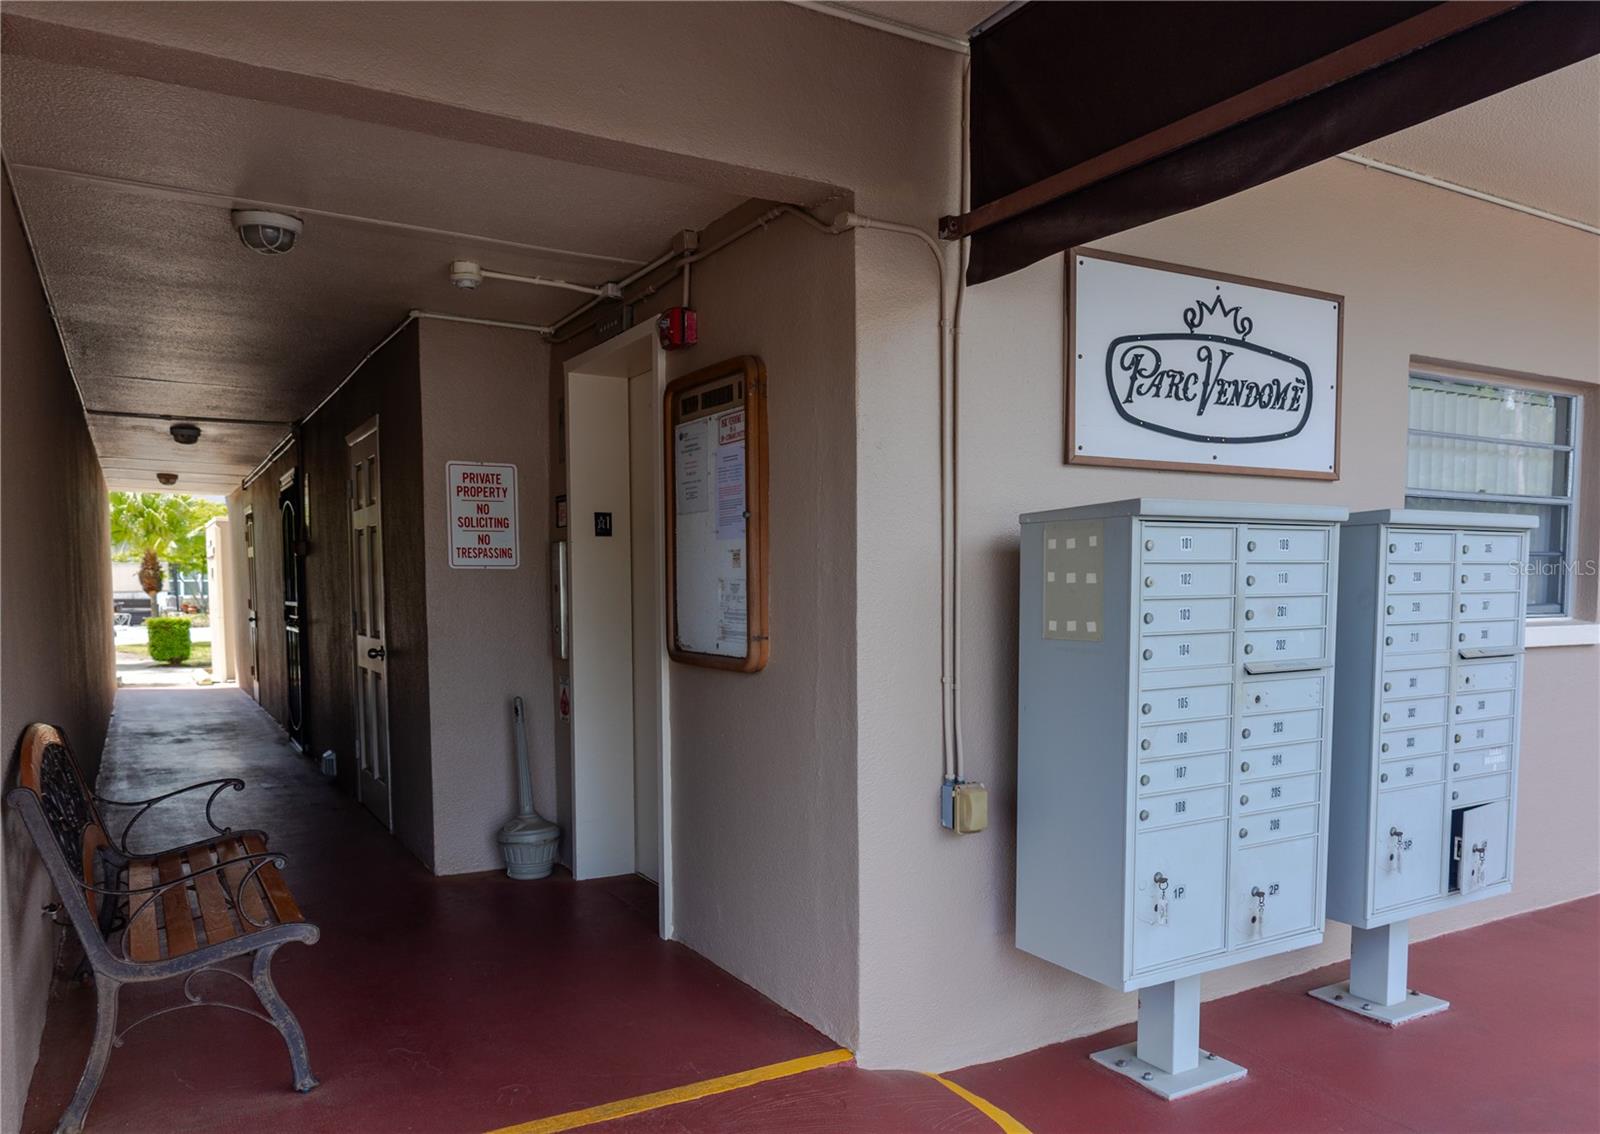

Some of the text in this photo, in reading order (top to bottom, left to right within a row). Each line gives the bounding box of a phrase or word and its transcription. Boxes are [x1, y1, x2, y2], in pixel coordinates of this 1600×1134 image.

[1120, 345, 1198, 404] PARC
[462, 472, 502, 485] PRIVATE
[456, 485, 508, 498] PROPERTY
[476, 503, 490, 515] NO
[457, 516, 510, 529] SOLICITING
[477, 534, 491, 545] NO
[1181, 537, 1192, 549] 101
[456, 547, 513, 559] TRESPASSING
[1180, 573, 1191, 585] 102
[1278, 573, 1288, 584] 110
[1179, 609, 1191, 620] 103
[1277, 606, 1287, 617] 201
[1179, 644, 1190, 656] 104
[1275, 639, 1286, 650] 202
[1177, 697, 1188, 709] 105
[1273, 722, 1283, 733] 203
[1176, 732, 1187, 743] 106
[1272, 755, 1282, 766] 204
[1176, 766, 1187, 778] 107
[1271, 787, 1281, 798] 205
[1175, 801, 1186, 813] 108
[1270, 819, 1280, 831] 206
[1174, 887, 1185, 899] 1P
[1269, 884, 1279, 896] 2P
